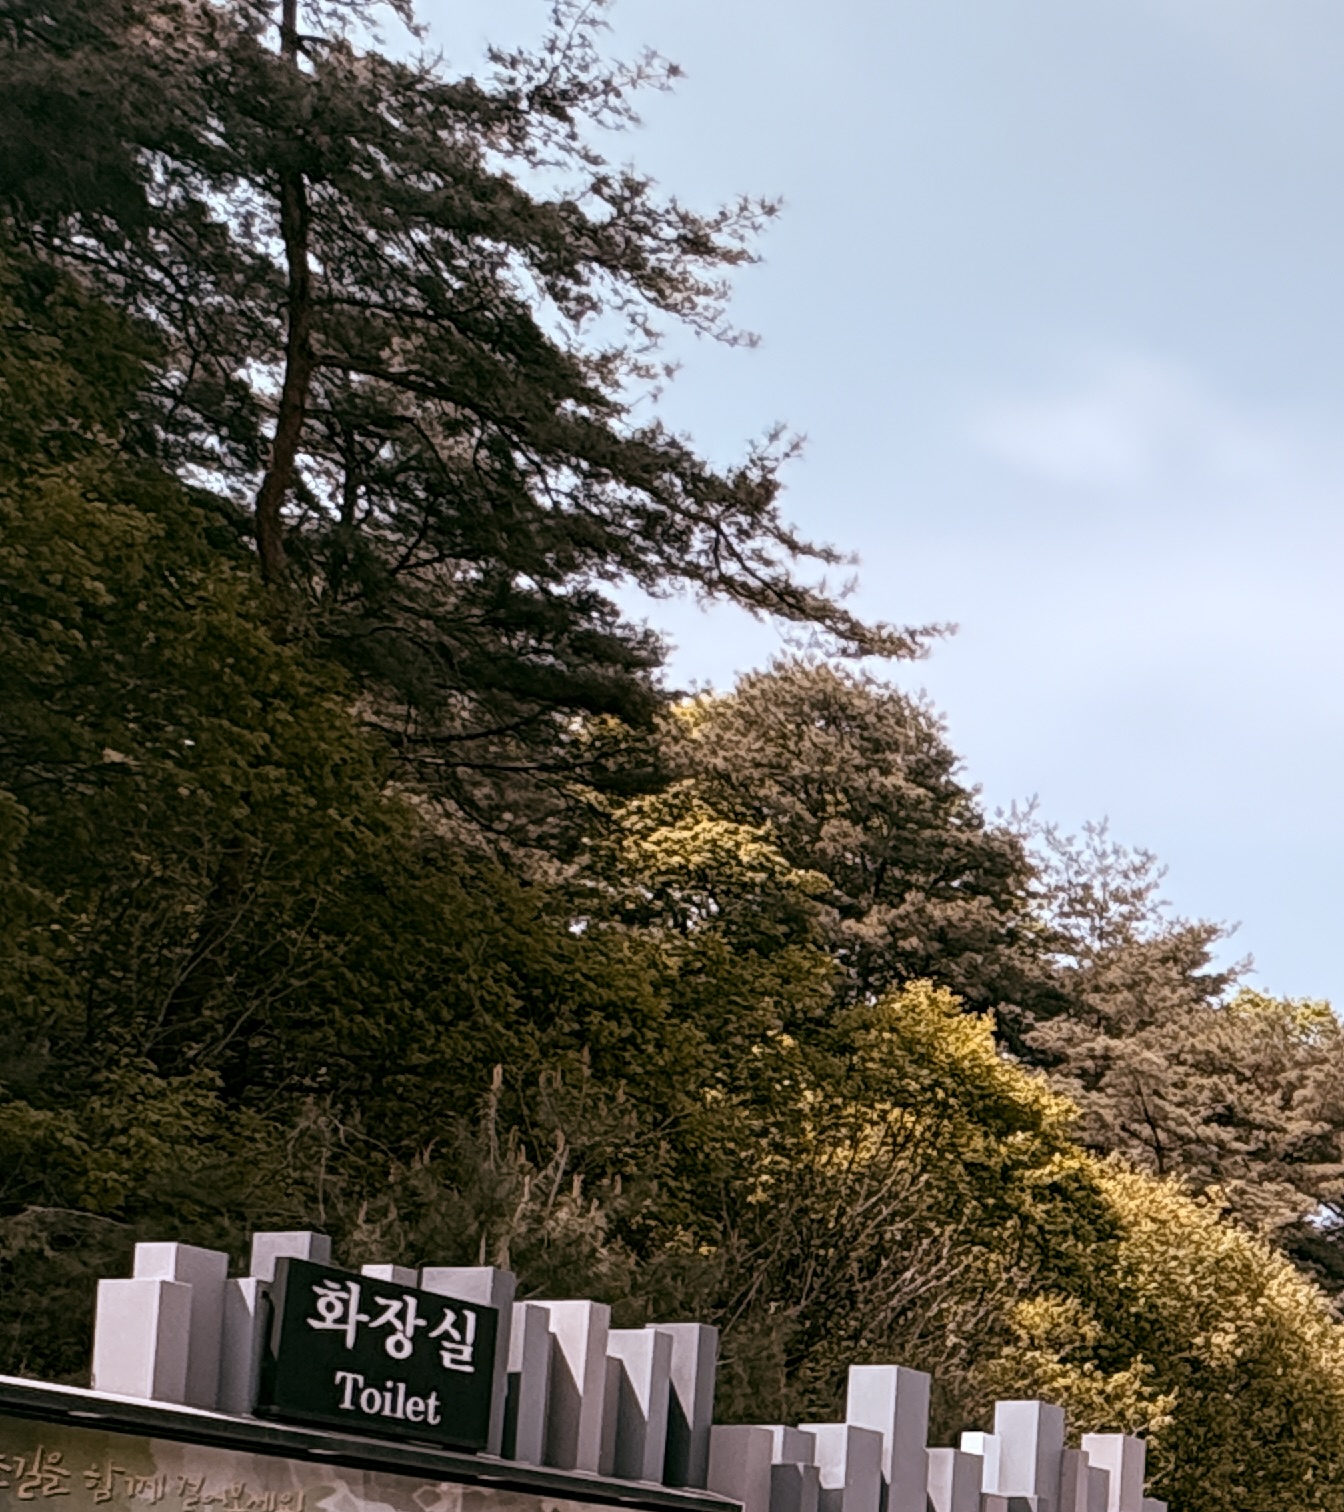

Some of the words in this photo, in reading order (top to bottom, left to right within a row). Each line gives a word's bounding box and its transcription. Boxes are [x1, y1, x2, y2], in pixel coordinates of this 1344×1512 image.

[306, 1279, 476, 1373] 화장실
[334, 1371, 441, 1425] Toilet
[83, 1458, 167, 1505] 함께
